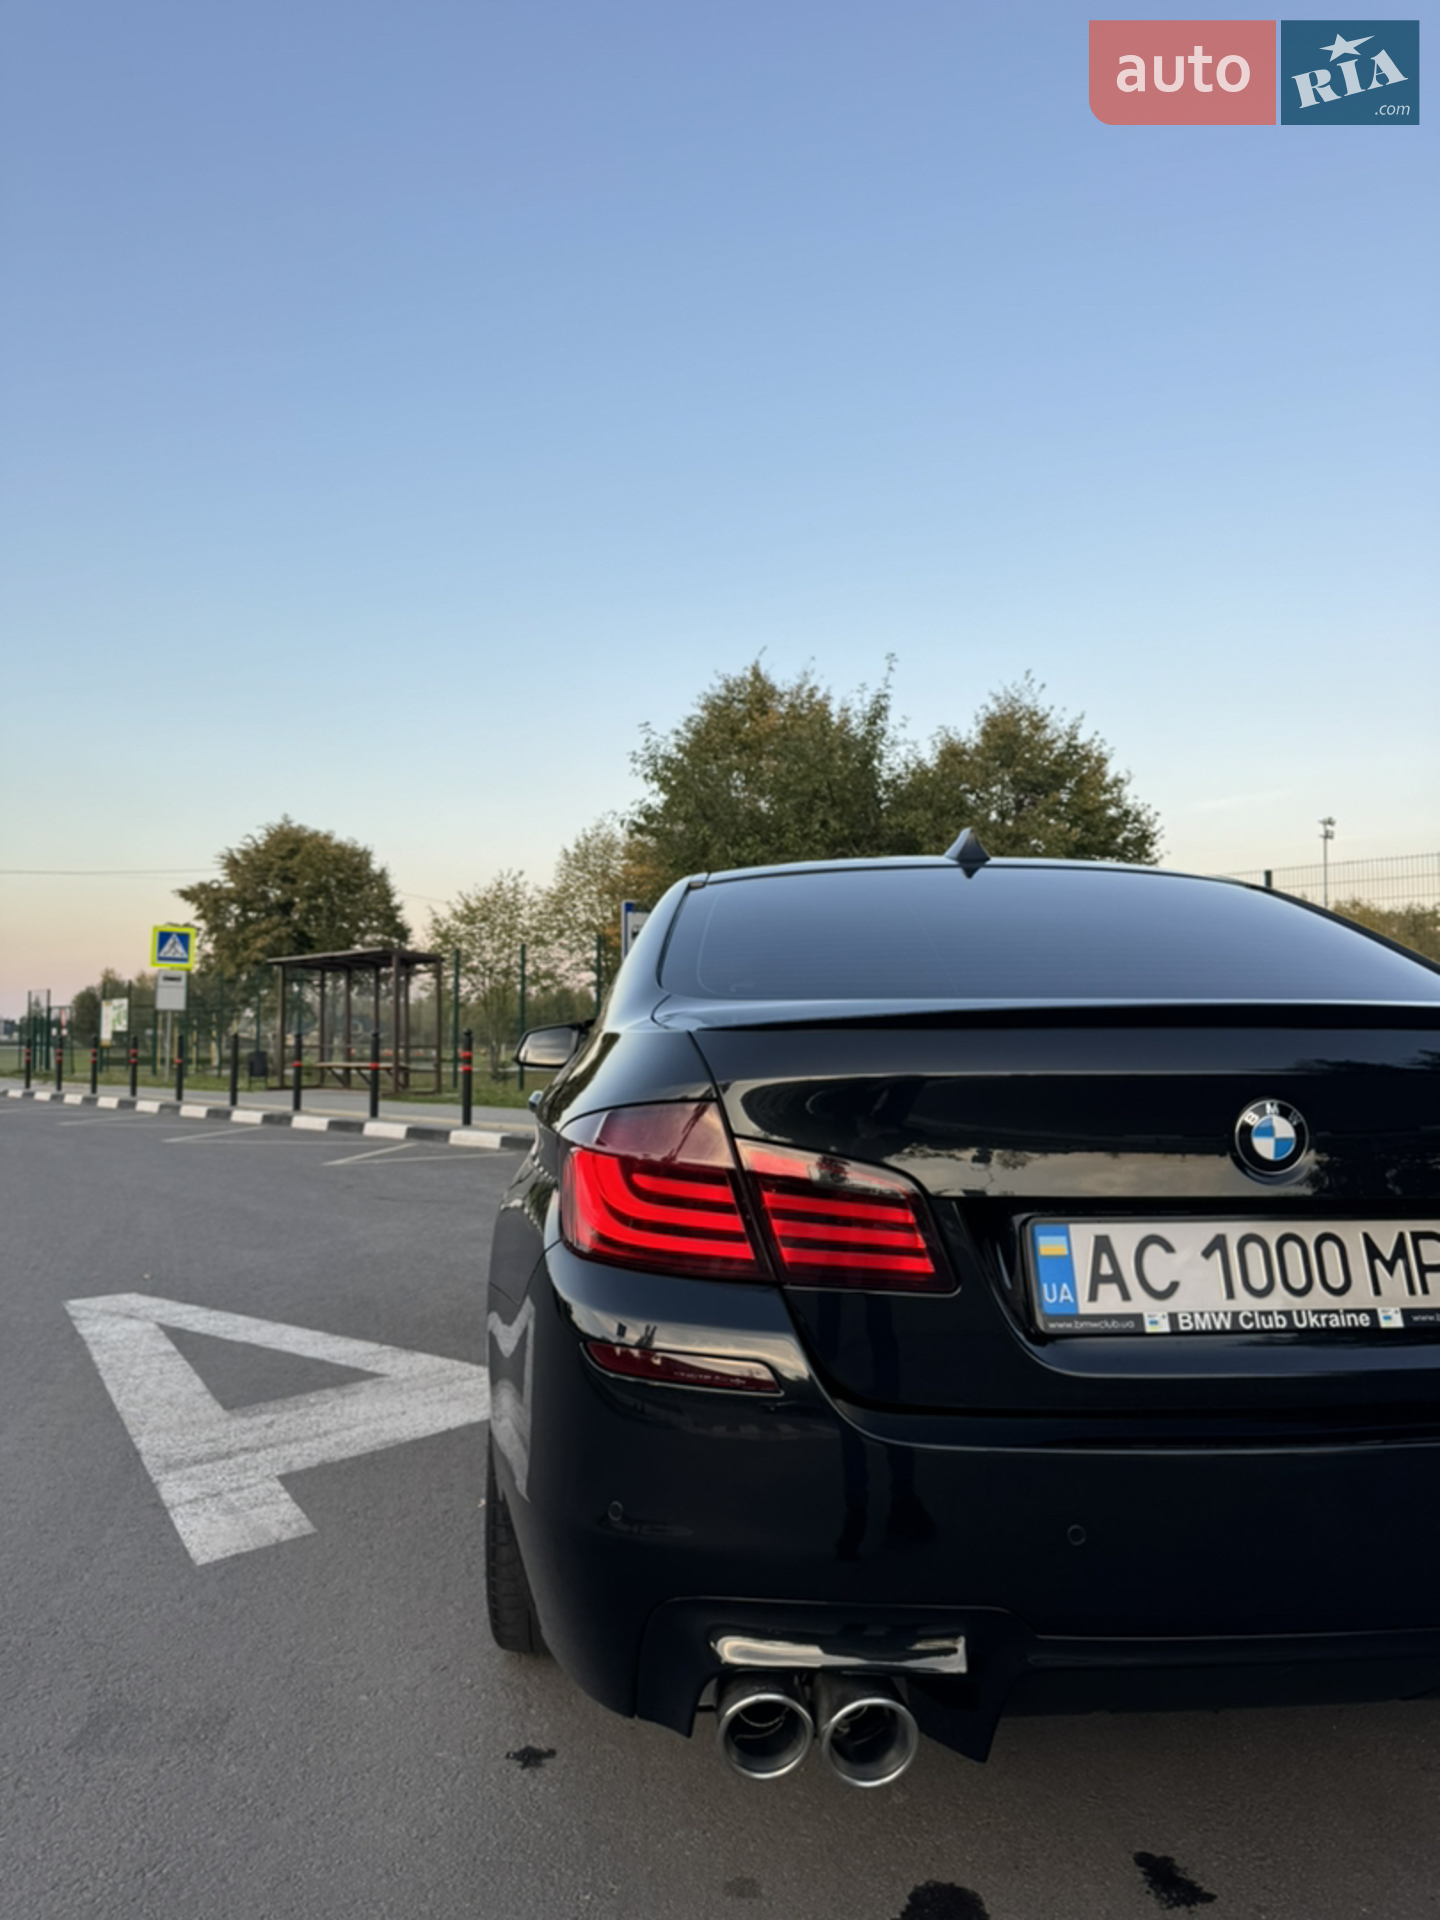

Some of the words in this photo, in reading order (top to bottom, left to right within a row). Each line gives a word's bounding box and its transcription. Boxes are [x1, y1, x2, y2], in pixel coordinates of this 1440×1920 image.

[1243, 1101, 1304, 1127] BMW
[1086, 1233, 1181, 1303] AC
[1200, 1231, 1353, 1301] 1000
[1360, 1230, 1440, 1298] MP
[1042, 1283, 1075, 1304] UA
[1177, 1312, 1232, 1332] BMW
[1238, 1311, 1285, 1330] Club
[1294, 1311, 1370, 1328] Ukraine
